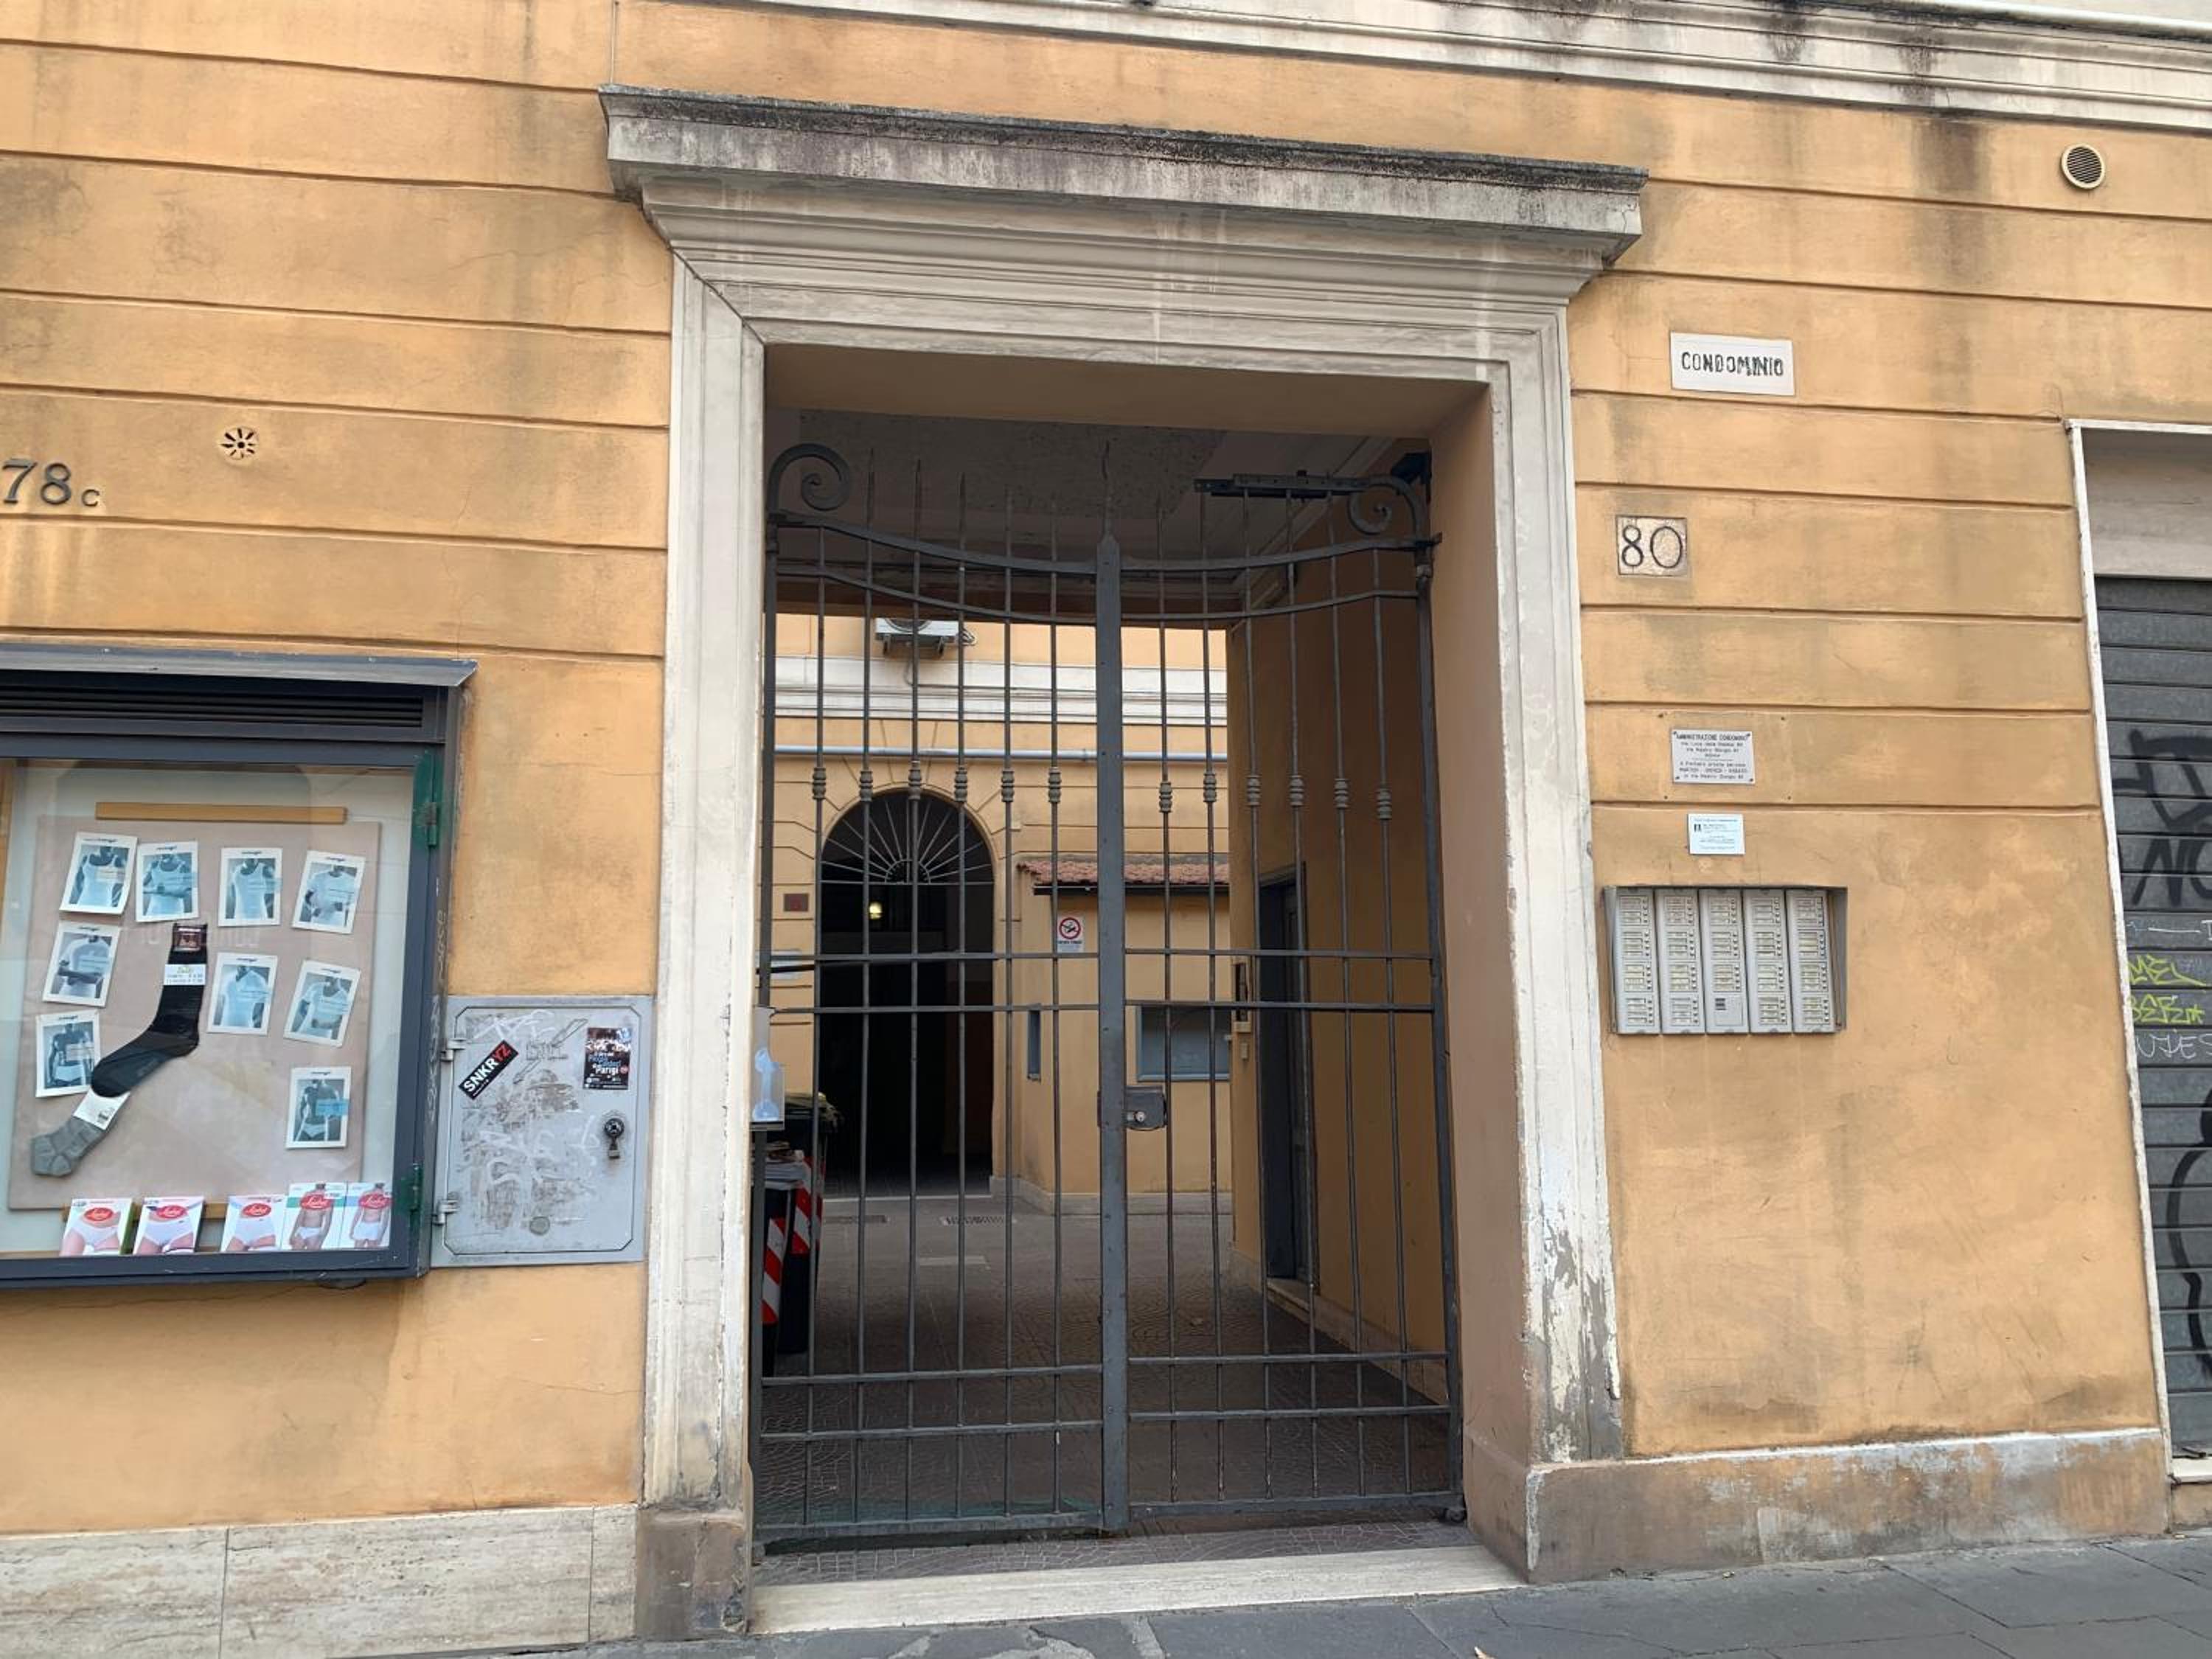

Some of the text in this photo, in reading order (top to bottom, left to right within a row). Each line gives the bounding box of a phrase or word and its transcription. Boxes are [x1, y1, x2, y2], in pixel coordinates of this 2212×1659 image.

[1681, 351, 1784, 377] CONDOMINIO
[1621, 524, 1683, 569] 80
[463, 1043, 512, 1093] SNKRYZ
